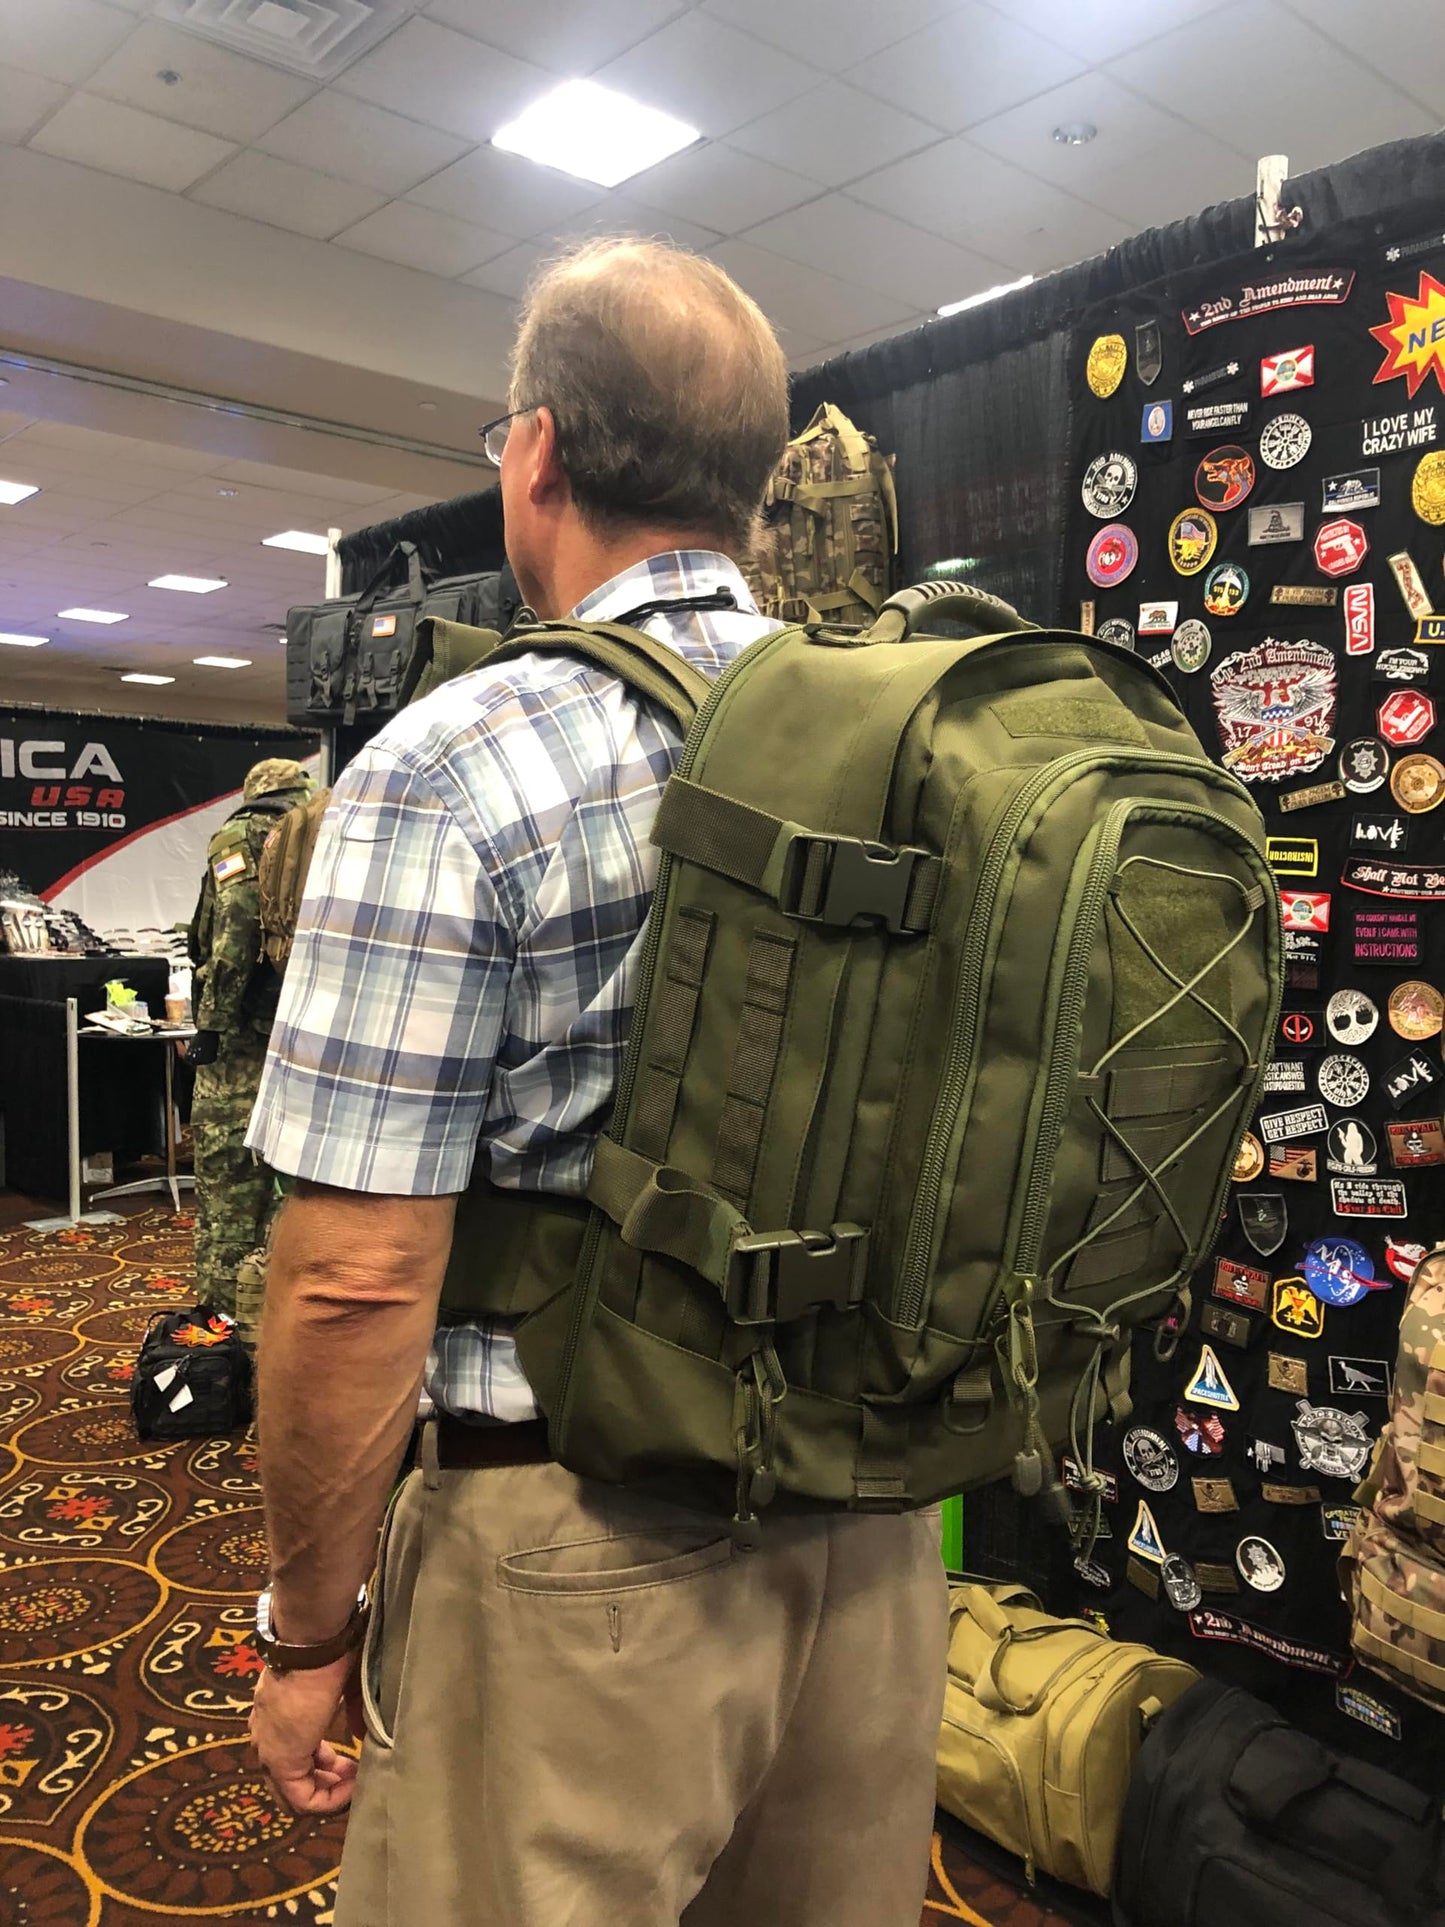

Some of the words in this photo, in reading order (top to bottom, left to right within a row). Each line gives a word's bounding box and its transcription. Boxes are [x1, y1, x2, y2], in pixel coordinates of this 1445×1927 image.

[1201, 297, 1232, 317] 2nd
[1239, 275, 1333, 308] Amendment
[1187, 408, 1203, 420] NEVER
[1213, 403, 1233, 416] FASTER
[1233, 402, 1248, 414] THAN
[1231, 414, 1242, 426] FLY
[1363, 421, 1368, 439] I
[1372, 414, 1408, 435] LOVE
[1414, 407, 1435, 426] MY
[1362, 435, 1405, 456] CRAZY
[1406, 424, 1437, 447] WIFE
[1351, 588, 1369, 651] NASA
[1212, 666, 1237, 686] The
[1239, 655, 1263, 673] 2nd
[1265, 647, 1336, 669] Amendment
[0, 739, 125, 783] ICA
[30, 786, 126, 808] USA
[0, 811, 68, 827] SINCE
[76, 811, 127, 829] 1910
[1268, 850, 1314, 863] INSTRUCTOR
[1351, 866, 1388, 883] Shall
[1390, 871, 1419, 887] Not
[1381, 927, 1401, 938] CAME
[1400, 928, 1418, 938] WITH
[1354, 943, 1418, 958] INSTRUCTIONS
[1280, 1071, 1305, 1081] ANSWER
[1283, 1061, 1304, 1072] WANT
[1263, 1117, 1284, 1130] GIVE
[1284, 1107, 1323, 1125] RESPECT
[1266, 1127, 1284, 1140] GET
[1285, 1118, 1323, 1136] RESPECT
[1315, 1244, 1361, 1299] NASA
[1203, 1611, 1233, 1629] 2nd
[1238, 1622, 1330, 1664] Amendment
